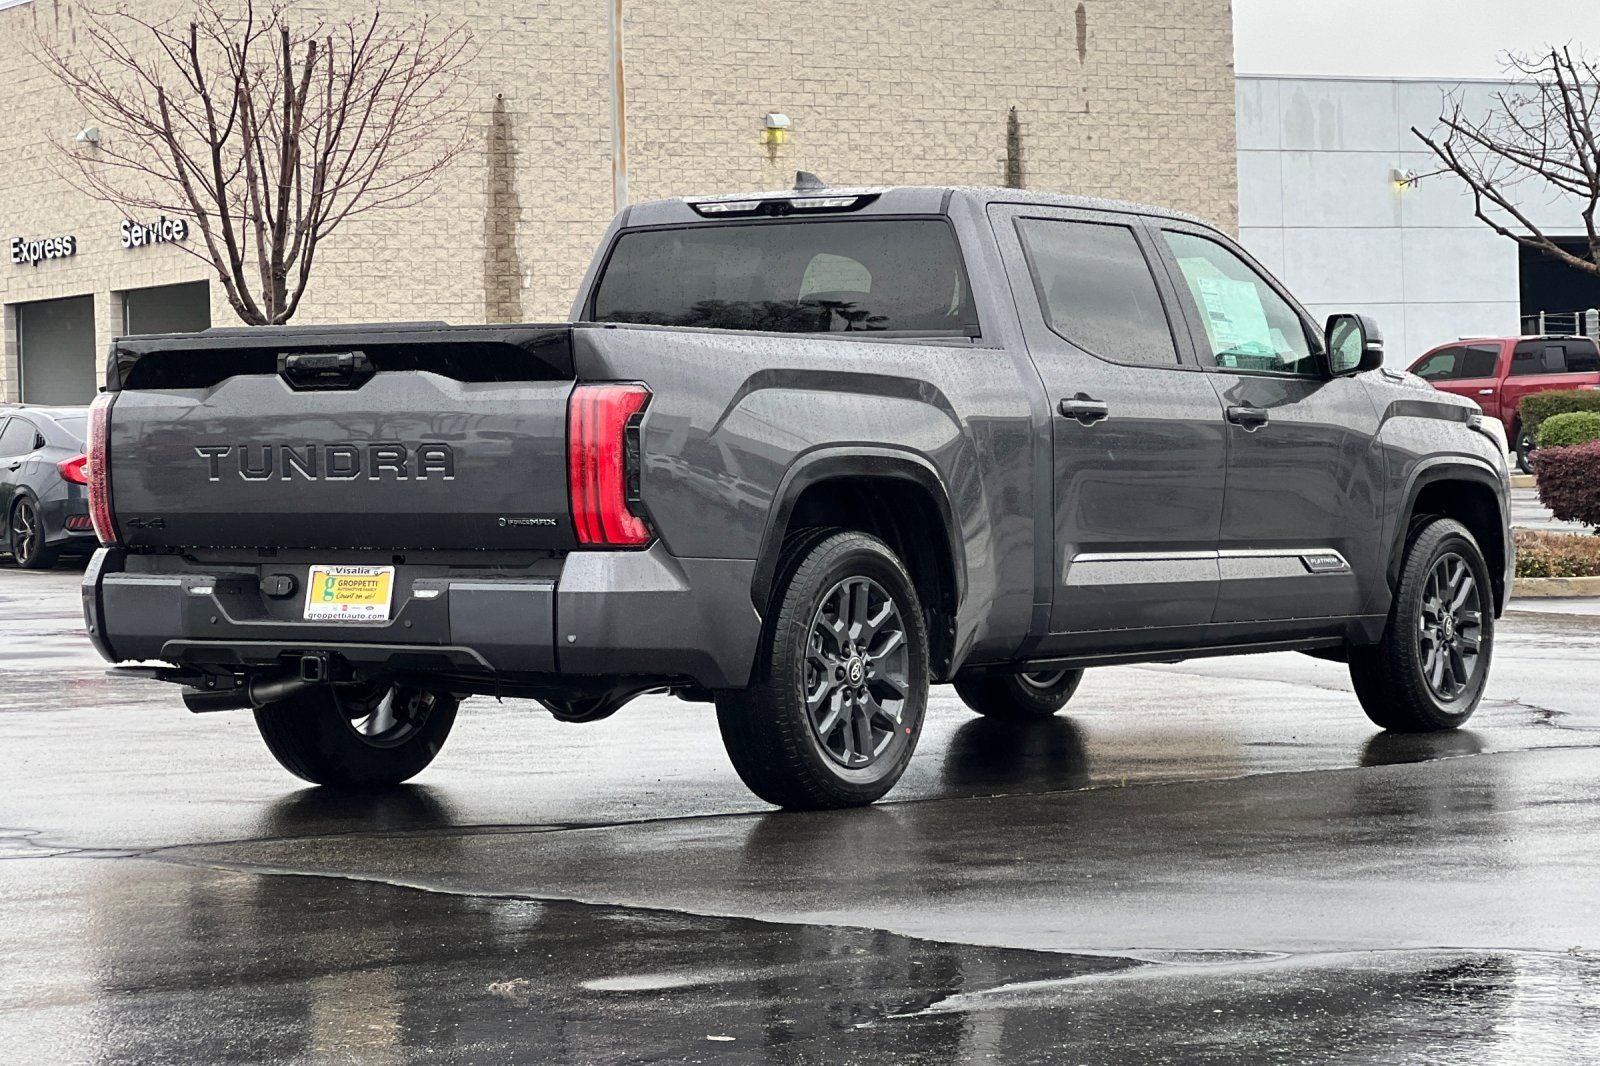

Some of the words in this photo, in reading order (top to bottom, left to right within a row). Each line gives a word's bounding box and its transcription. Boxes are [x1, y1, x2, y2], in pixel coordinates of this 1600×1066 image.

[11, 236, 76, 267] Express
[120, 216, 189, 249] Service
[195, 443, 455, 481] TUNDRA
[335, 567, 370, 575] Visalia
[338, 579, 378, 587] GROPPETTI
[308, 612, 385, 620] groppettiauto.com
